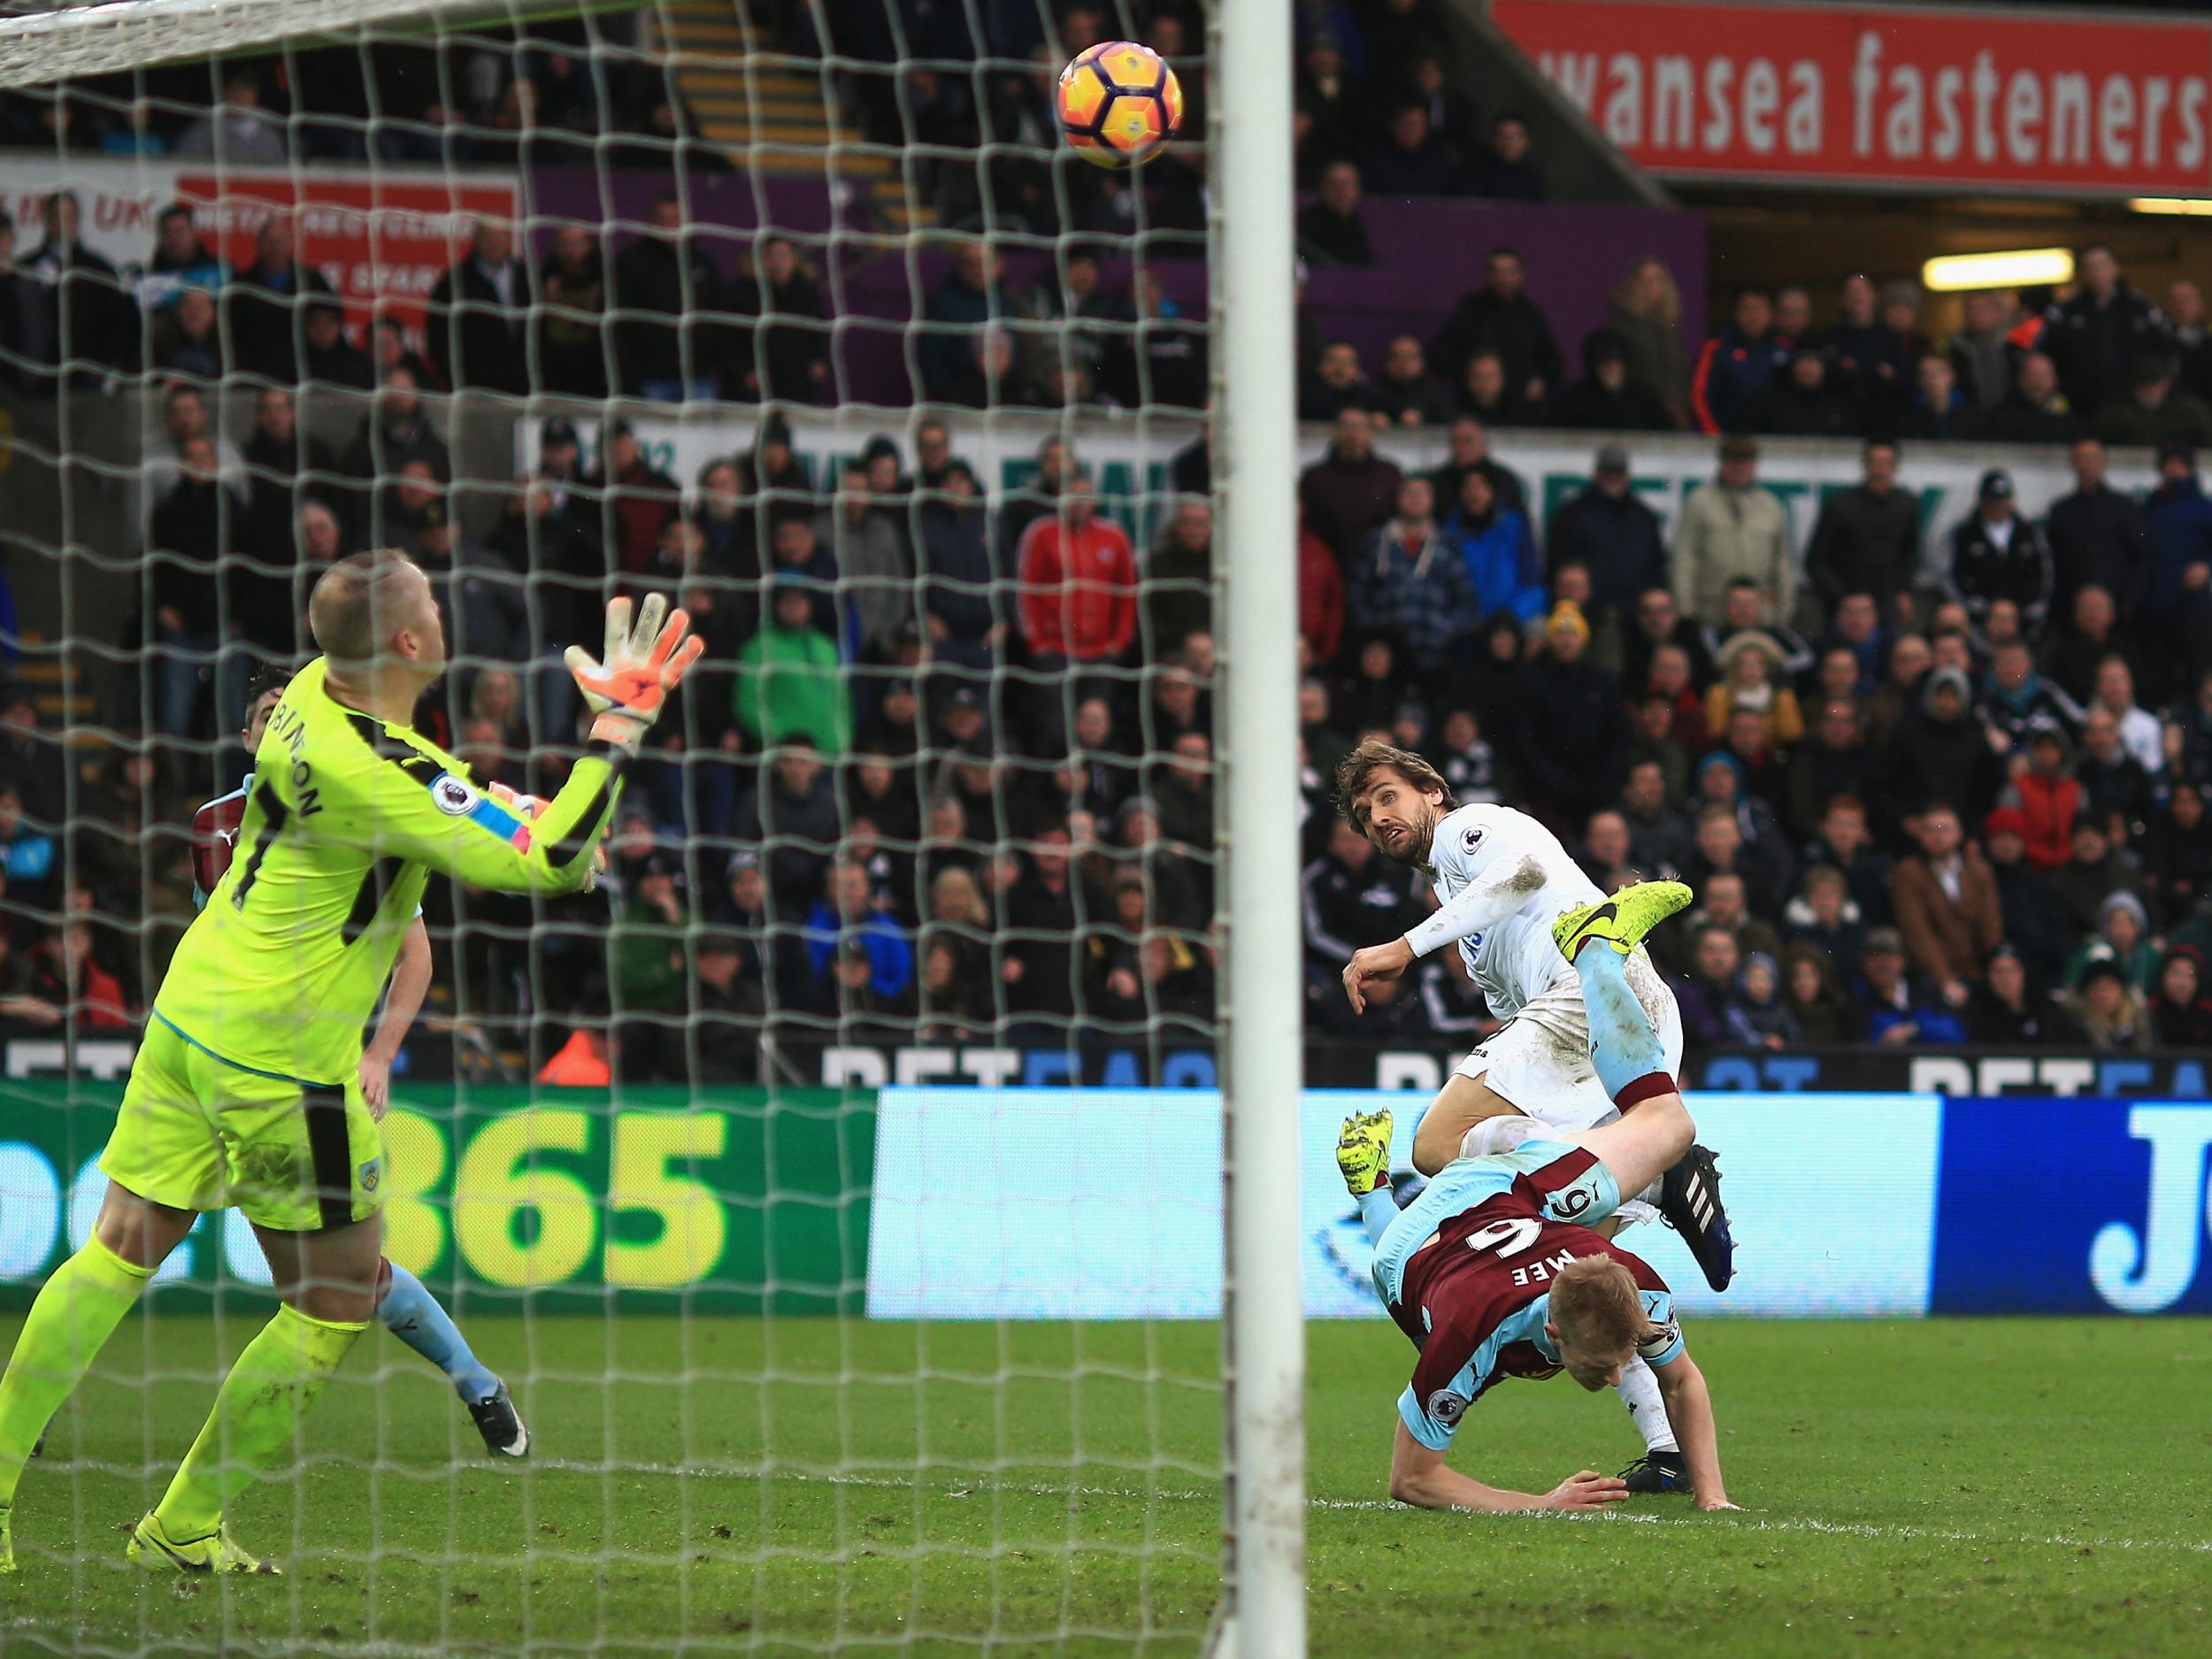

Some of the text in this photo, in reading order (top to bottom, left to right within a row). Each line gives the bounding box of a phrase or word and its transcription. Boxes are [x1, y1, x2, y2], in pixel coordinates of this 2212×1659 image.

[1851, 30, 2208, 171] fasteners
[1510, 1248, 1579, 1286] MEE
[2089, 1102, 2212, 1315] J
